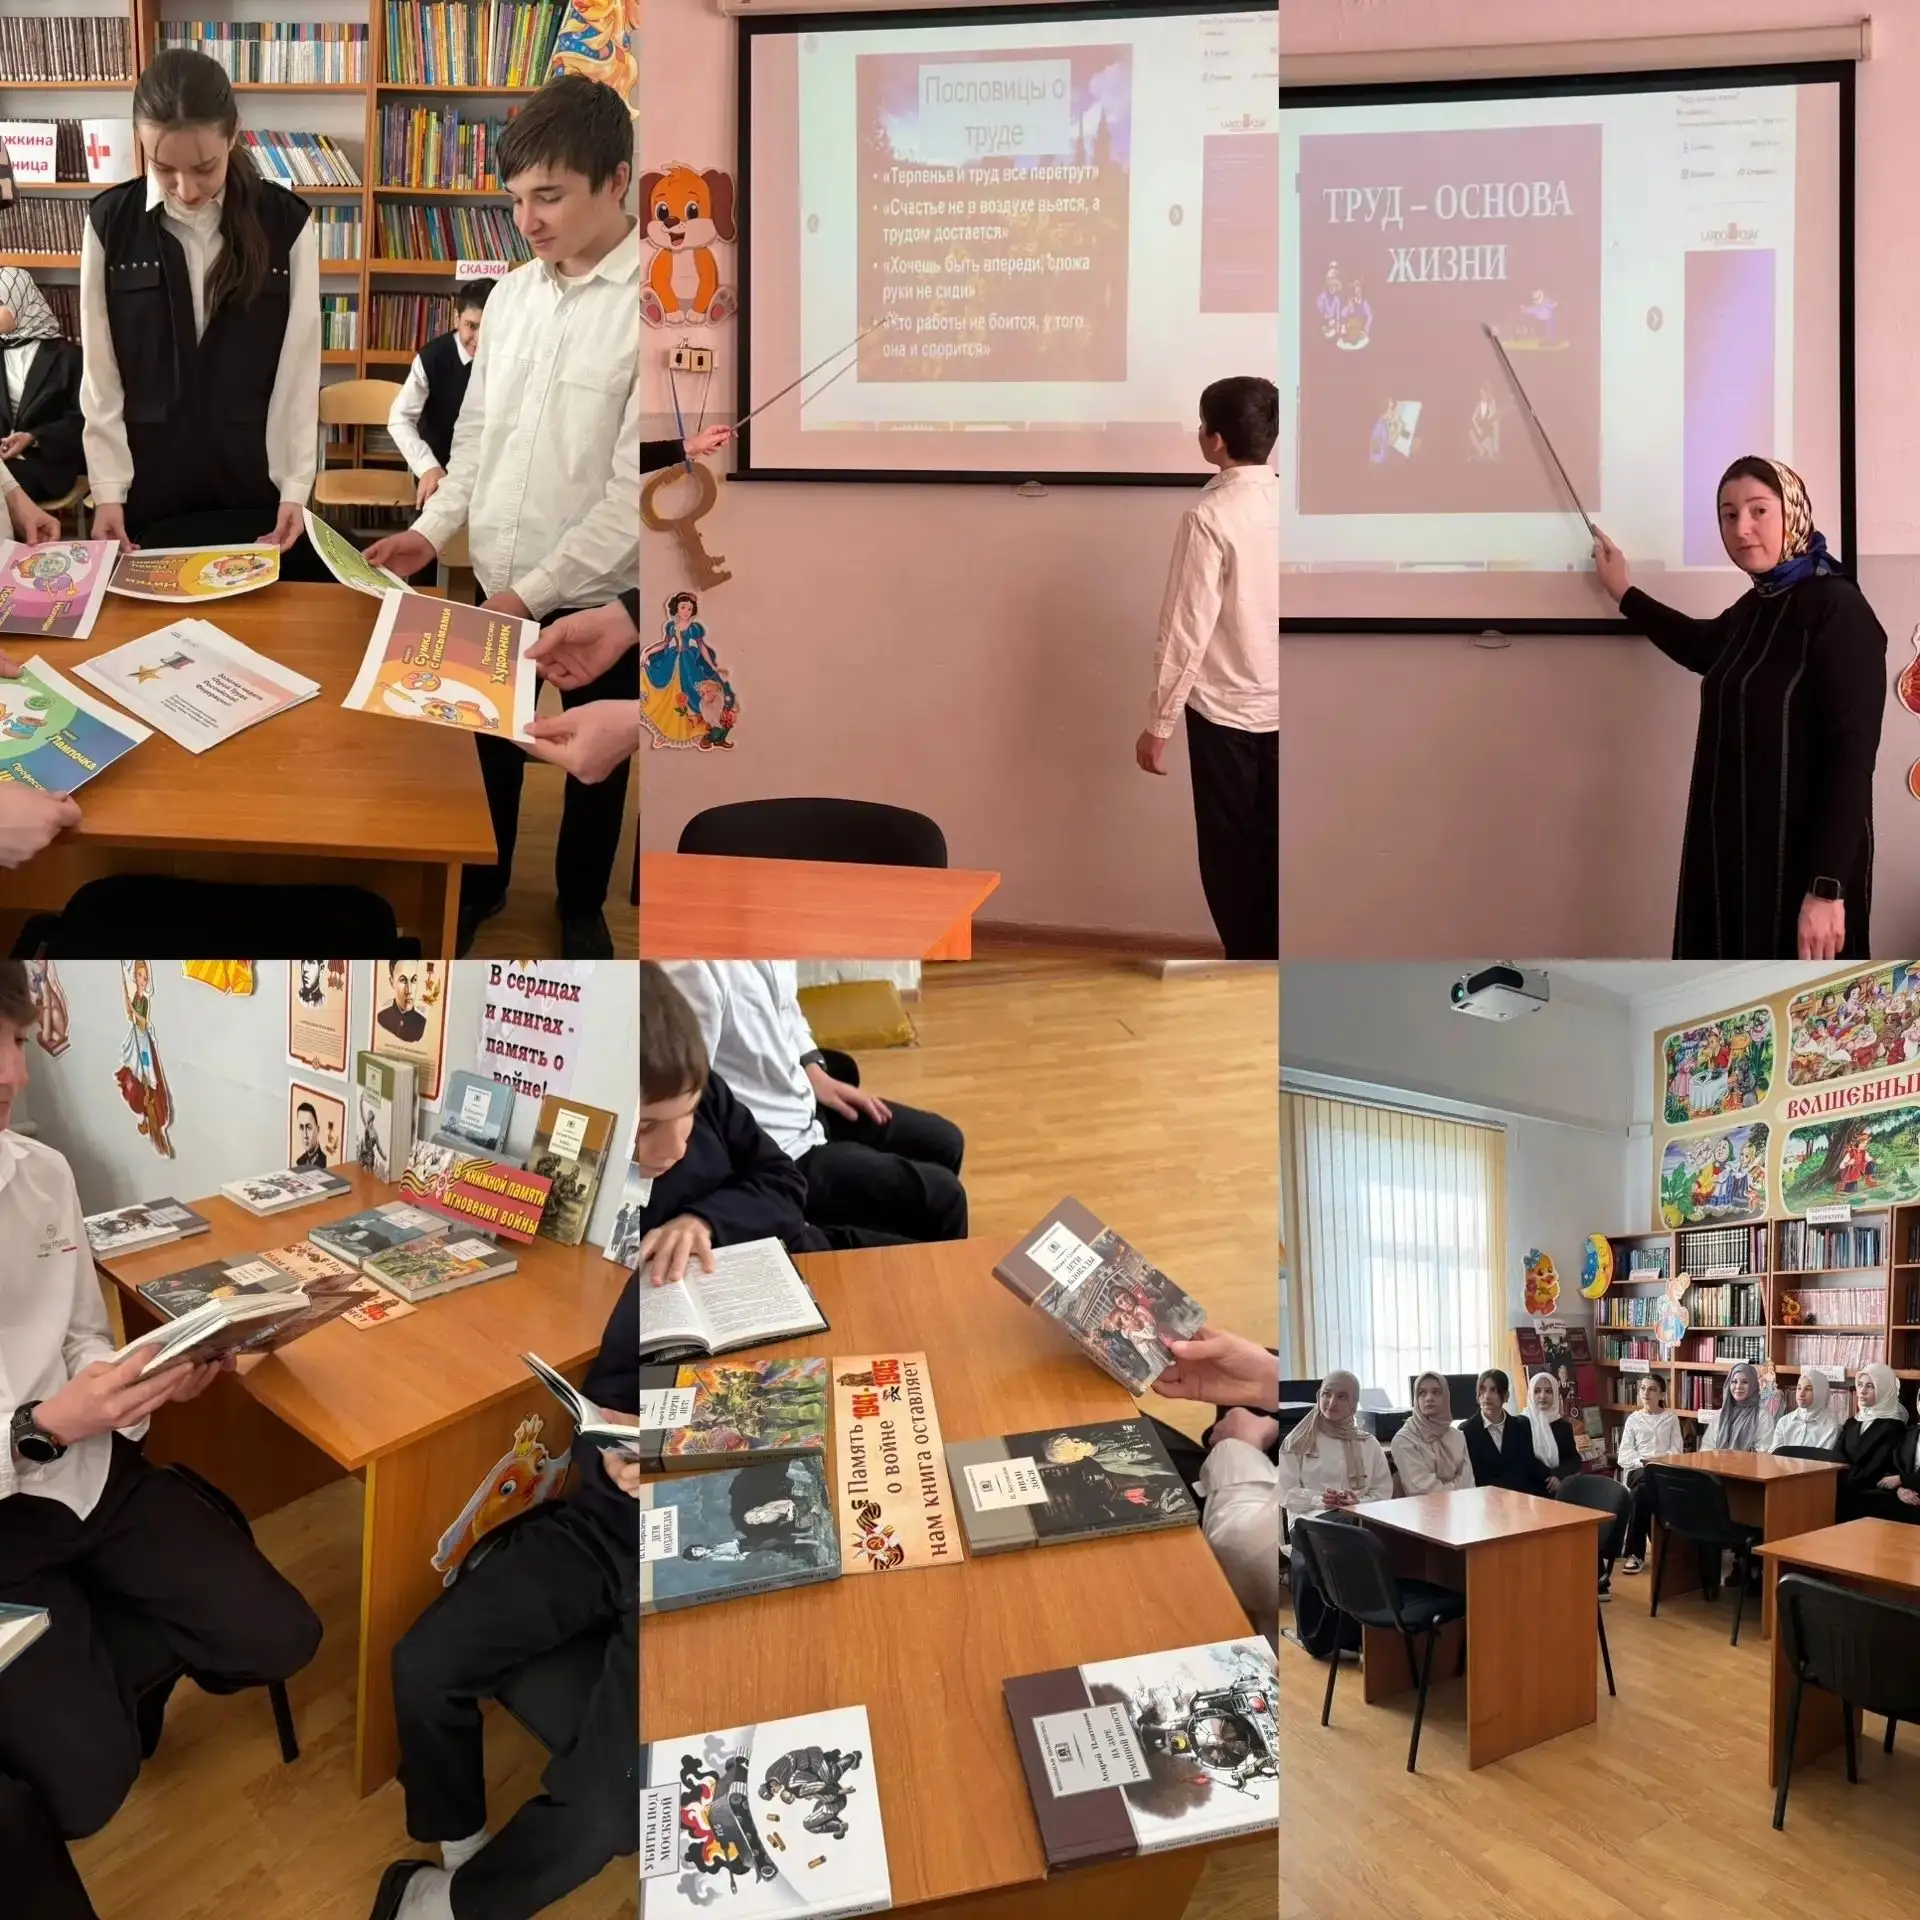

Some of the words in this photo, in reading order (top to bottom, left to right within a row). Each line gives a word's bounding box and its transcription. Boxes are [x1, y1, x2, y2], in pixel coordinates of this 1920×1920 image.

[925, 75, 1046, 106] Пословицы
[1052, 77, 1065, 100] о
[964, 124, 1025, 154] труде
[883, 166, 954, 188] «Терпенье
[956, 167, 966, 183] и
[969, 166, 1000, 186] труд
[1002, 167, 1028, 182] все
[1030, 165, 1100, 186] перетрут»
[883, 198, 946, 217] «Счастье
[947, 200, 965, 215] не
[967, 200, 977, 214] в
[979, 198, 1035, 217] воздухе
[1038, 198, 1089, 215] вьется,
[1091, 196, 1101, 212] а
[1322, 185, 1405, 232] ТРУД
[1434, 180, 1575, 220] ОСНОВА
[882, 226, 931, 245] трудом
[933, 224, 1009, 244] достается»
[459, 263, 506, 276] СКАЗКИ
[884, 256, 942, 274] «Хочешь
[944, 254, 980, 273] быть
[983, 255, 1044, 274] впереди,
[1047, 254, 1091, 271] сложа
[1385, 243, 1508, 284] ЖИЗНИ
[882, 285, 914, 303] руки
[916, 285, 932, 299] не
[935, 284, 976, 300] сиди»
[916, 312, 968, 334] работы
[969, 315, 986, 330] не
[988, 312, 1040, 331] боится,
[1054, 313, 1084, 330] того
[882, 343, 906, 358] она
[909, 344, 918, 358] и
[921, 342, 992, 360] спорится»
[414, 632, 432, 666] Сумка
[432, 608, 451, 661] письмами
[490, 624, 512, 685] Художник
[48, 734, 97, 771] Лампочка
[489, 963, 503, 986] В
[506, 972, 582, 1003] сердцах
[484, 1003, 497, 1020] и
[500, 1007, 564, 1036] книгах
[485, 1037, 548, 1068] память
[553, 1054, 565, 1072] о
[453, 1160, 464, 1180] В
[463, 1168, 508, 1196] книжной
[507, 1182, 548, 1207] памяти
[442, 1191, 499, 1223] мгновения
[499, 1209, 540, 1236] войны
[852, 1394, 881, 1420] 1941
[871, 1358, 902, 1388] 1945
[903, 1360, 930, 1445] оставляет
[669, 1395, 680, 1420] СМЕРТИ
[847, 1423, 869, 1496] Память
[879, 1419, 900, 1478] войне
[886, 1482, 903, 1495] о
[914, 1450, 940, 1510] книга
[1014, 1470, 1028, 1492] ИВАН
[926, 1513, 948, 1558] нам
[1103, 1728, 1117, 1747] ЗАРЕ
[1109, 1706, 1126, 1737] ЮНОСТИ
[1095, 1752, 1110, 1783] Андрей
[1110, 1746, 1121, 1760] НА
[1119, 1738, 1141, 1779] ТУМАННОЙ
[647, 1792, 659, 1821] ПОД
[660, 1796, 673, 1861] МОСКВОЙ
[644, 1823, 657, 1872] УБИТЫ
